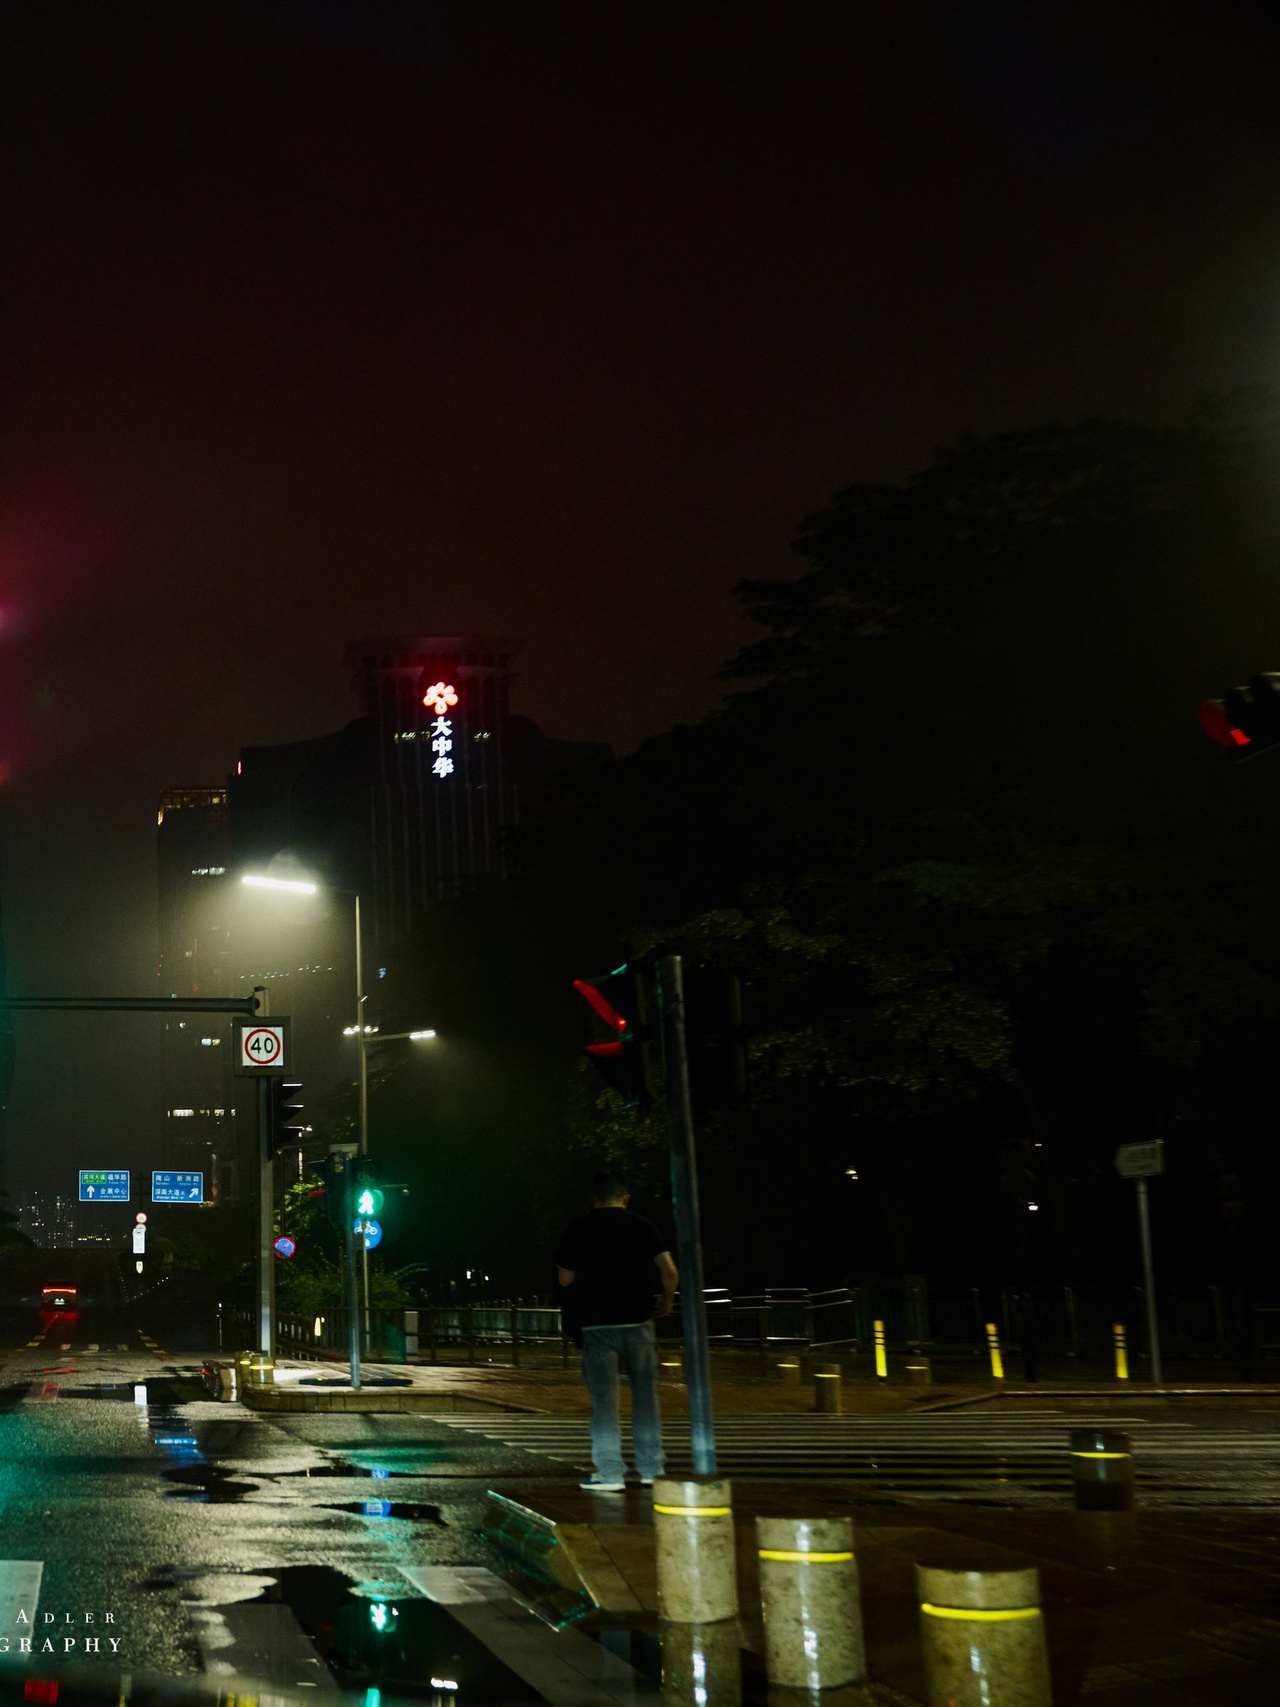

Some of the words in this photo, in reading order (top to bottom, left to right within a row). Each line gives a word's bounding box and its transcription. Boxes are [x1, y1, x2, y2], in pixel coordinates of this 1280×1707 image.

[430, 716, 455, 779] 大中华
[250, 1037, 274, 1054] 40
